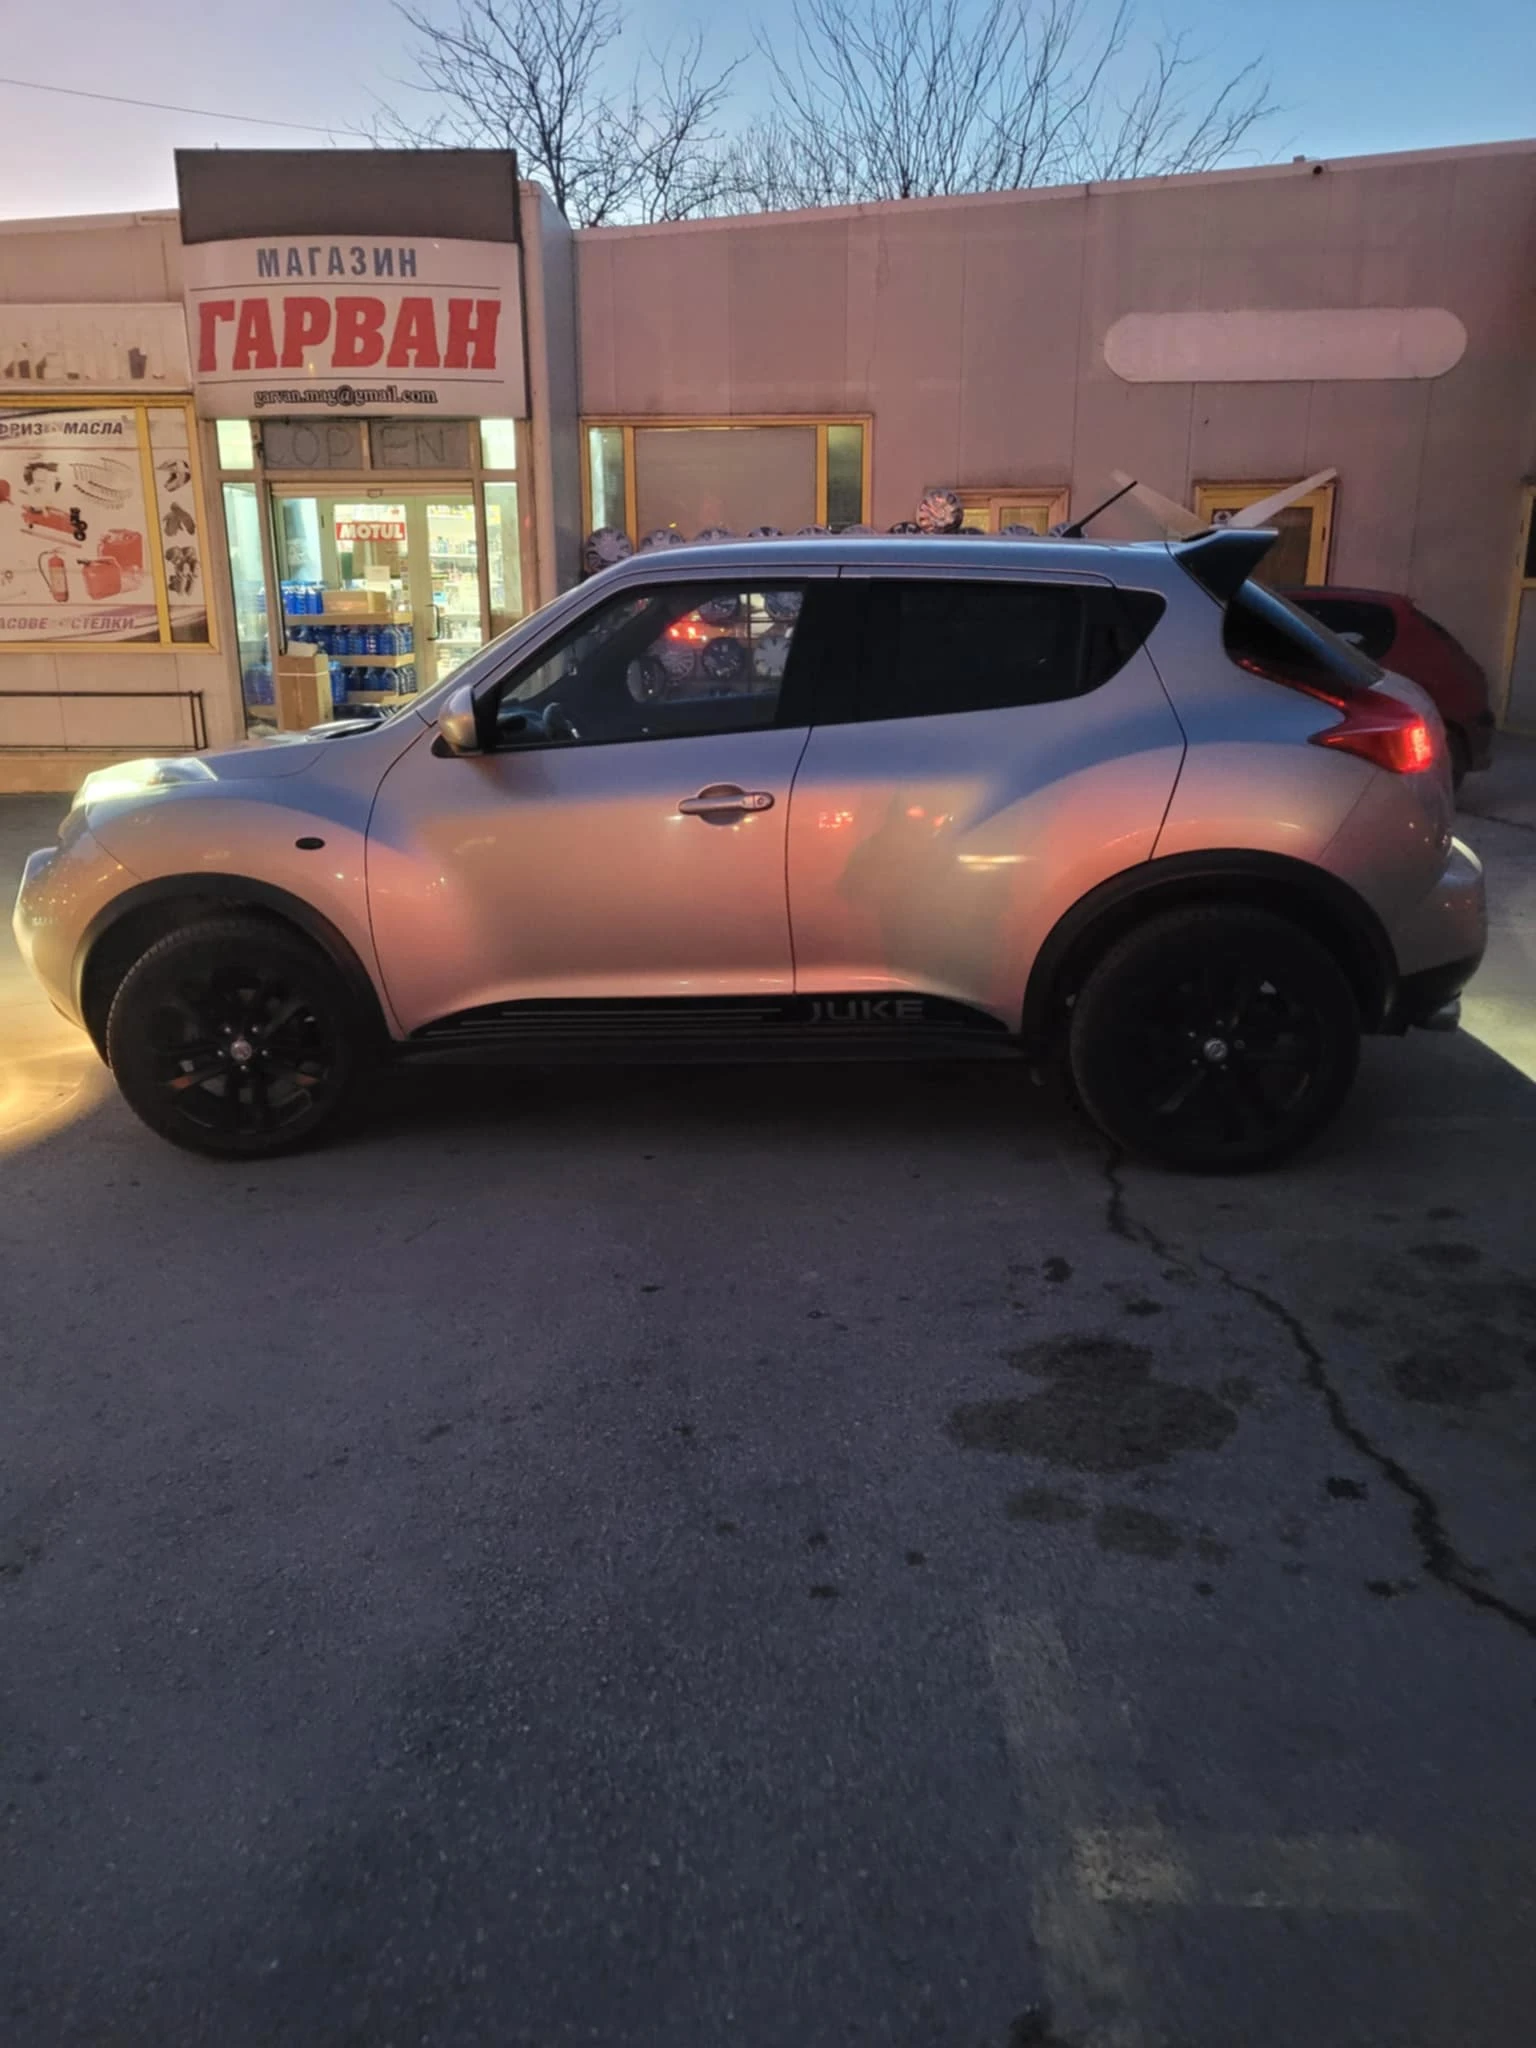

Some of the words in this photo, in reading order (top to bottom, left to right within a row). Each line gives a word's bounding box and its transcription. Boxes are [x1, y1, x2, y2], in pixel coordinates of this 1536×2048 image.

[256, 246, 418, 278] МАГАЗИН
[198, 296, 502, 373] ГАРВАН
[253, 385, 438, 408] garvan.mag@gmail.com
[63, 422, 122, 435] МАСЛА
[340, 523, 403, 539] MOTUL
[71, 617, 135, 630] СТЕЛКИ
[810, 999, 924, 1023] JUKE
